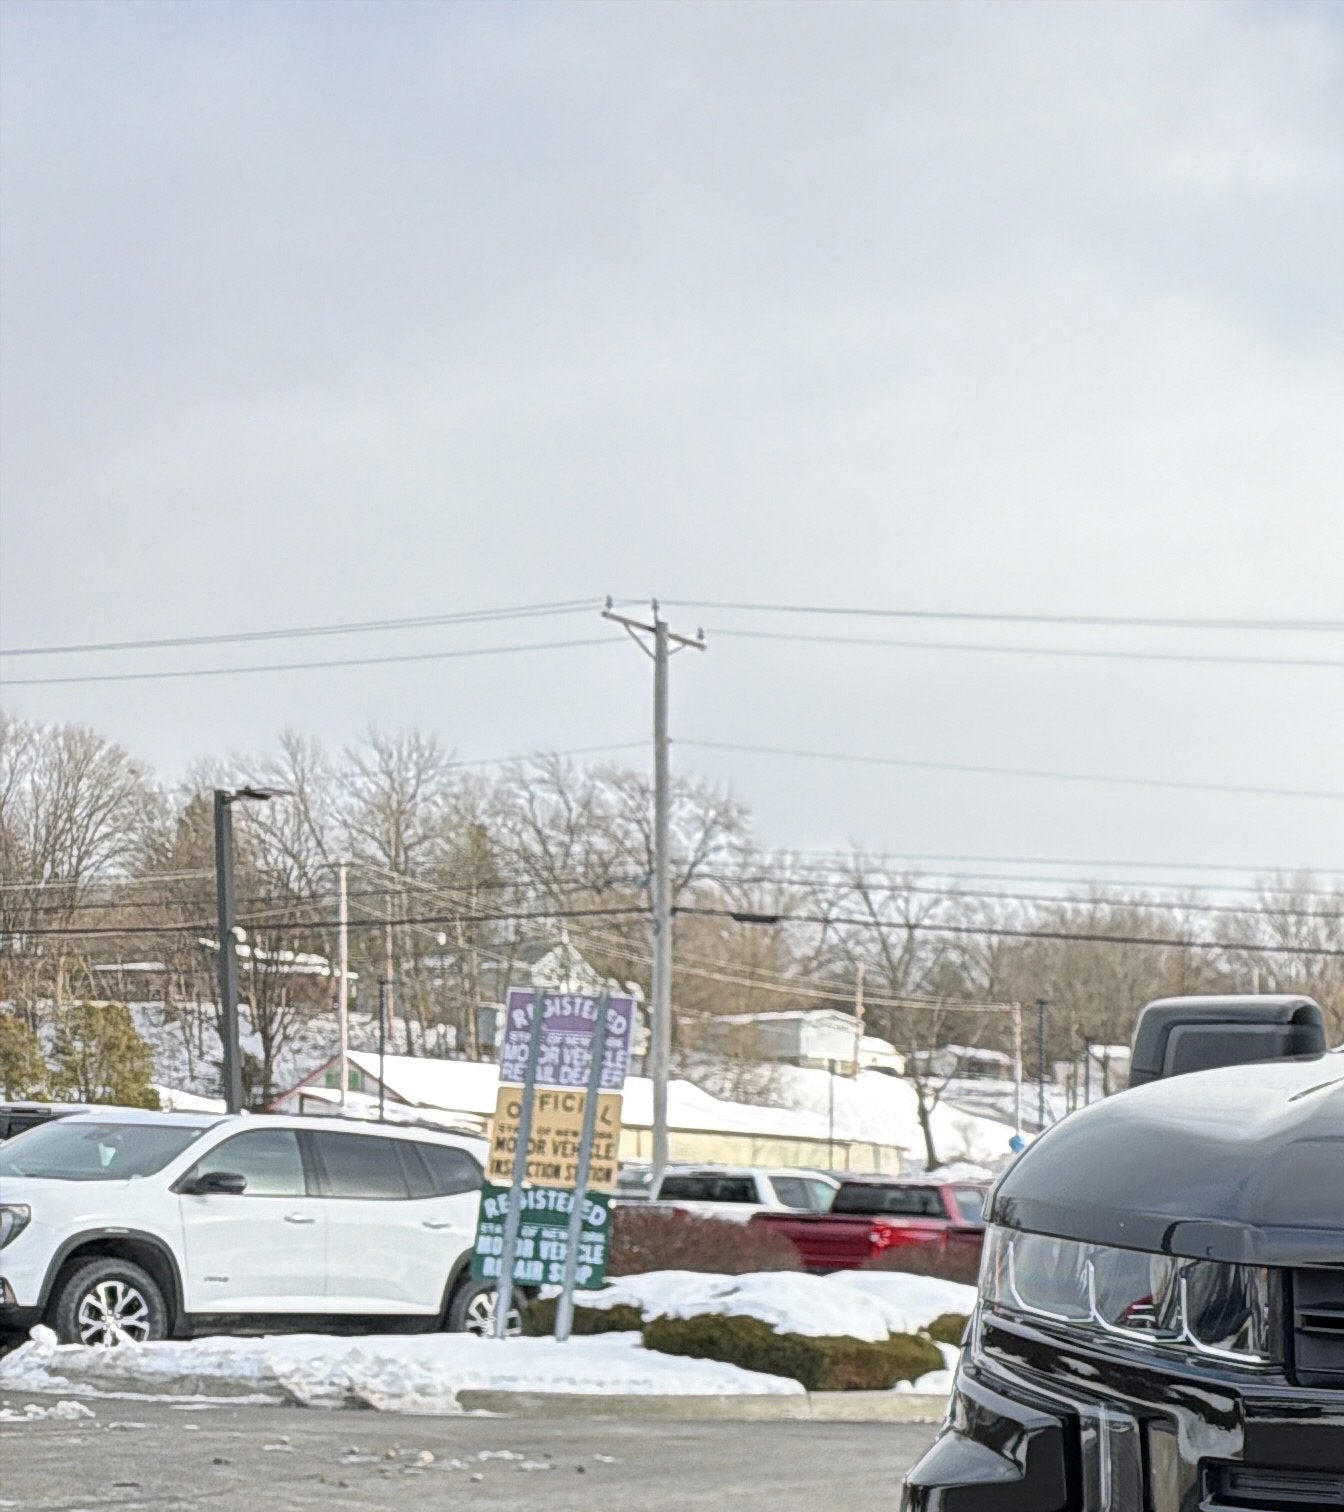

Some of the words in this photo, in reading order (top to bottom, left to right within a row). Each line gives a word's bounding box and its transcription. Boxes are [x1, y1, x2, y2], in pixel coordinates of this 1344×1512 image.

[511, 997, 627, 1035] RGISTEED
[504, 1042, 560, 1065] MOOR
[563, 1046, 628, 1070] VEHLE
[559, 1065, 624, 1087] DEAER
[506, 1093, 612, 1126] OFICIL
[495, 1136, 546, 1154] MOOR
[552, 1139, 614, 1161] VEHLE
[489, 1158, 562, 1178] INSCTION
[484, 1189, 607, 1226] REISTEED
[476, 1235, 535, 1258] MOOR
[482, 1256, 544, 1281] REAIR
